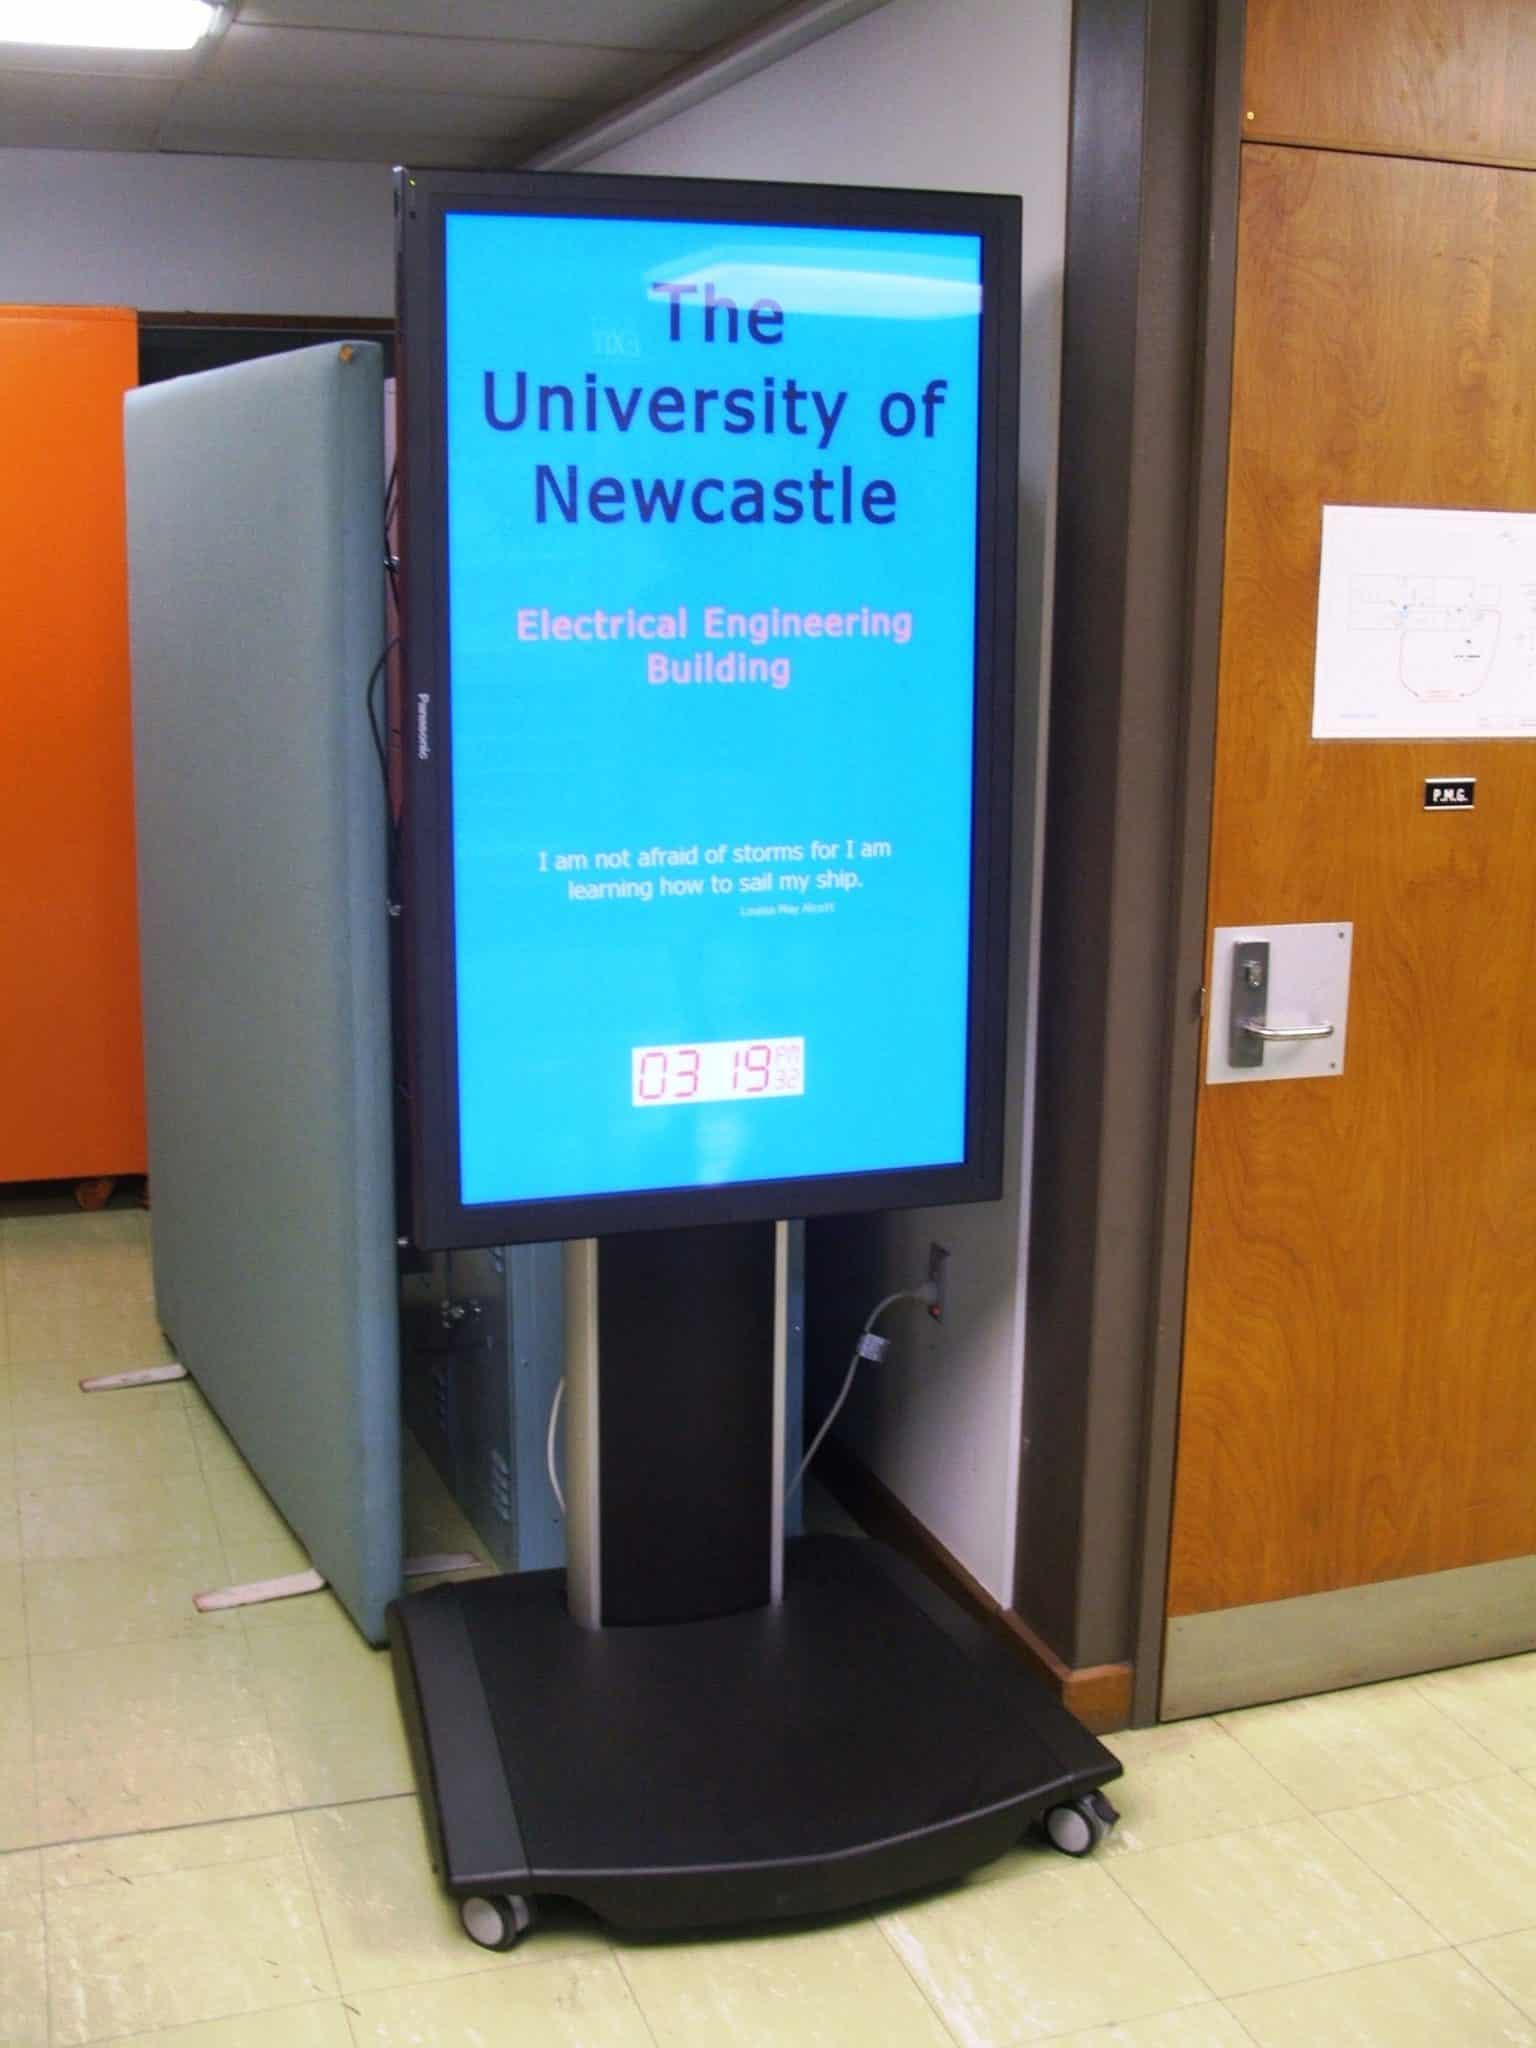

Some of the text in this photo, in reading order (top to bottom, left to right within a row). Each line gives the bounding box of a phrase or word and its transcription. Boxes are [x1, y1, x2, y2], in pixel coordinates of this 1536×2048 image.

[652, 281, 785, 344] The
[484, 371, 948, 449] University of
[535, 464, 897, 525] Newcastle
[516, 607, 912, 646] Electrical Engineering
[647, 652, 790, 689] Building
[538, 839, 892, 872] I am not afraid of storms for I am
[568, 869, 864, 901] learning how to sail my ship.
[639, 1050, 699, 1099] 03
